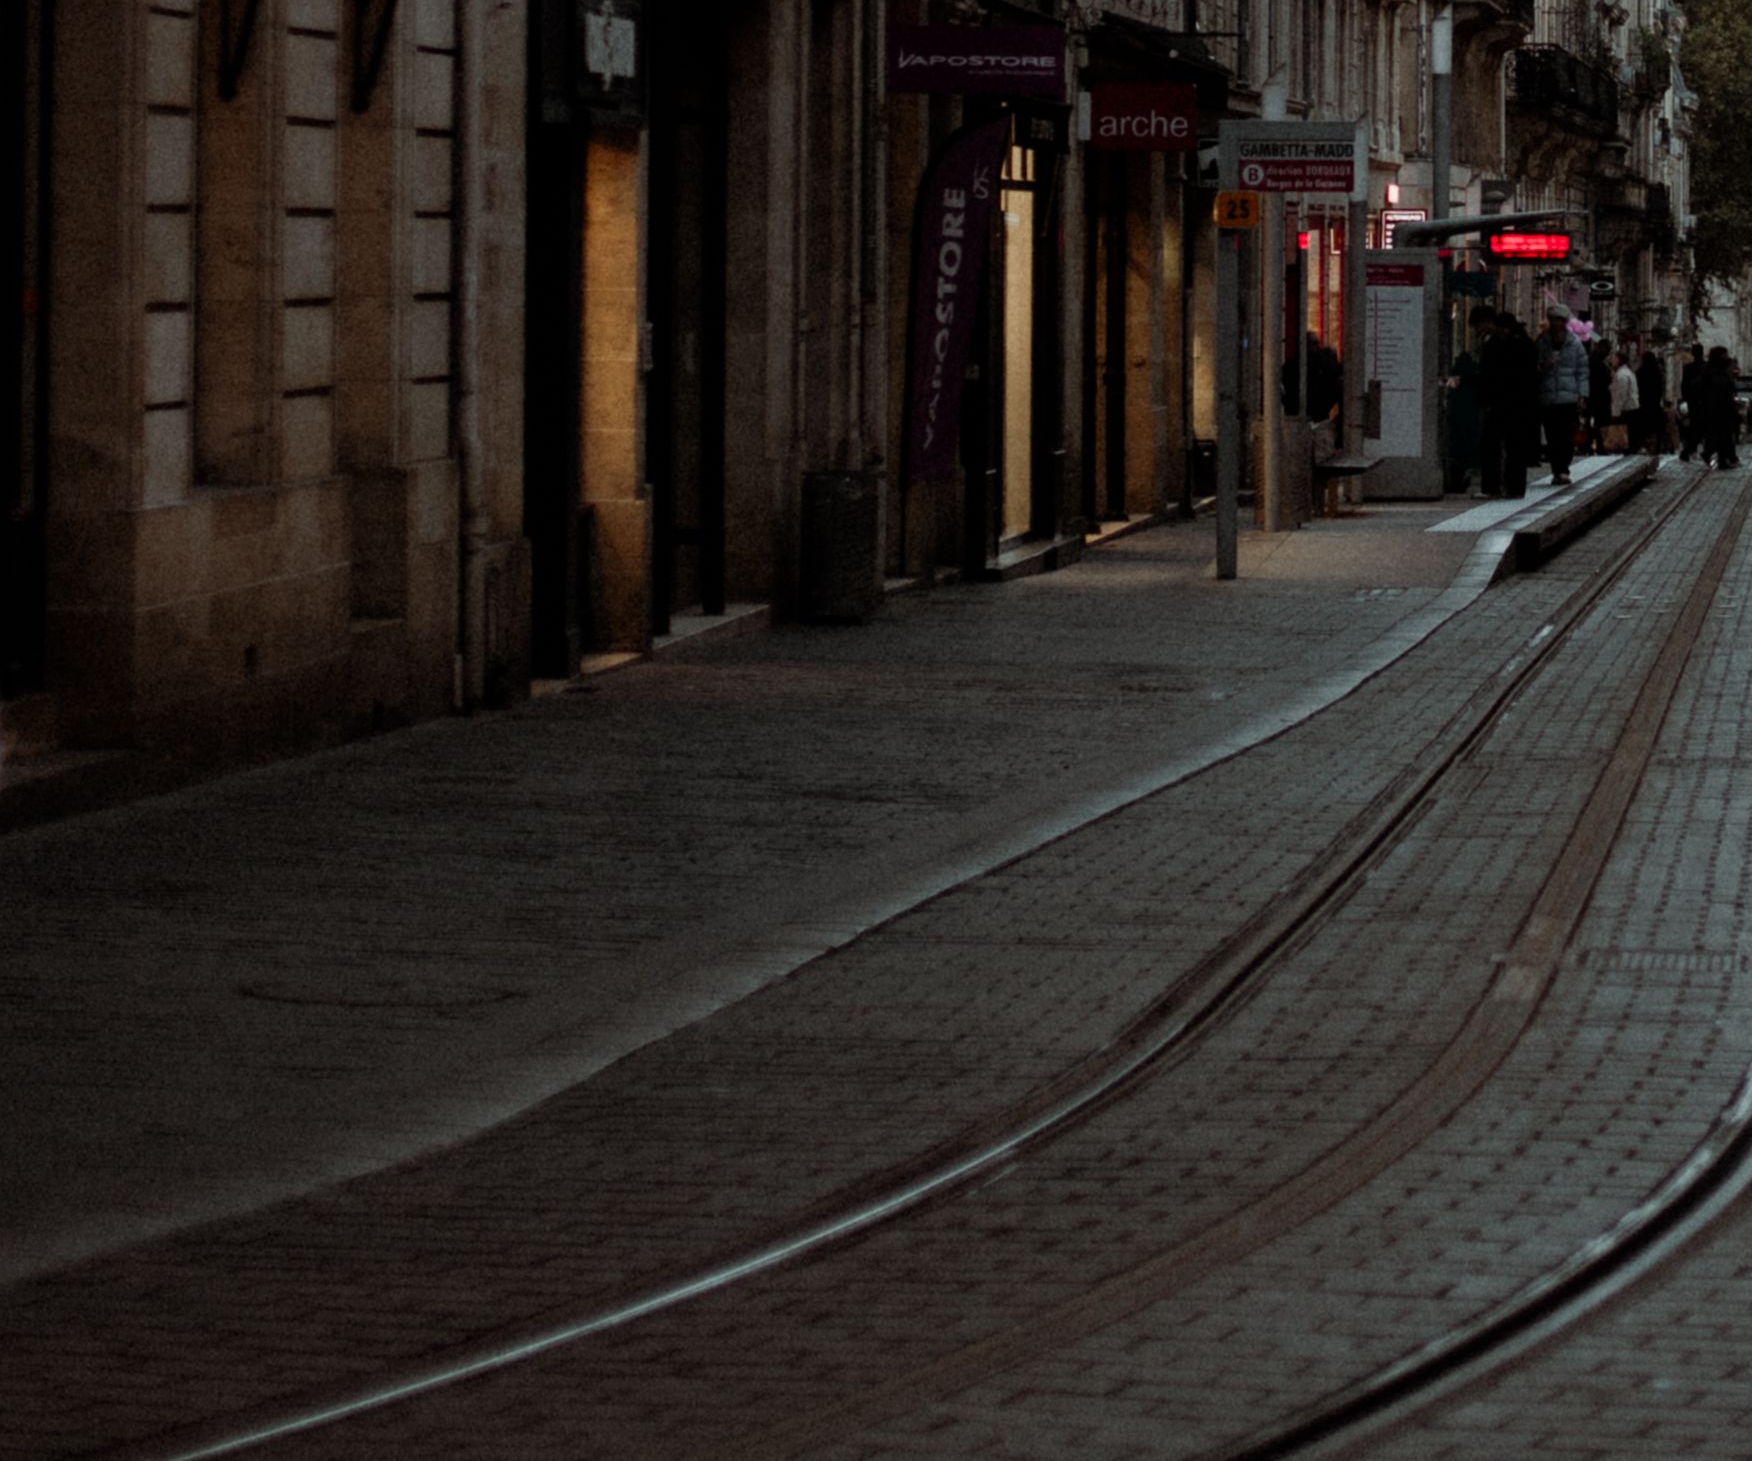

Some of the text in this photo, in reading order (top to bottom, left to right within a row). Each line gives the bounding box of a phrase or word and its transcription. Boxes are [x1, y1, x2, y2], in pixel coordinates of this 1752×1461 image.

[898, 49, 1057, 69] VAPOSTORE
[1099, 108, 1189, 138] arche
[1239, 142, 1354, 158] GAMBETTA-MADD
[1248, 167, 1258, 182] B
[1226, 199, 1250, 219] 25
